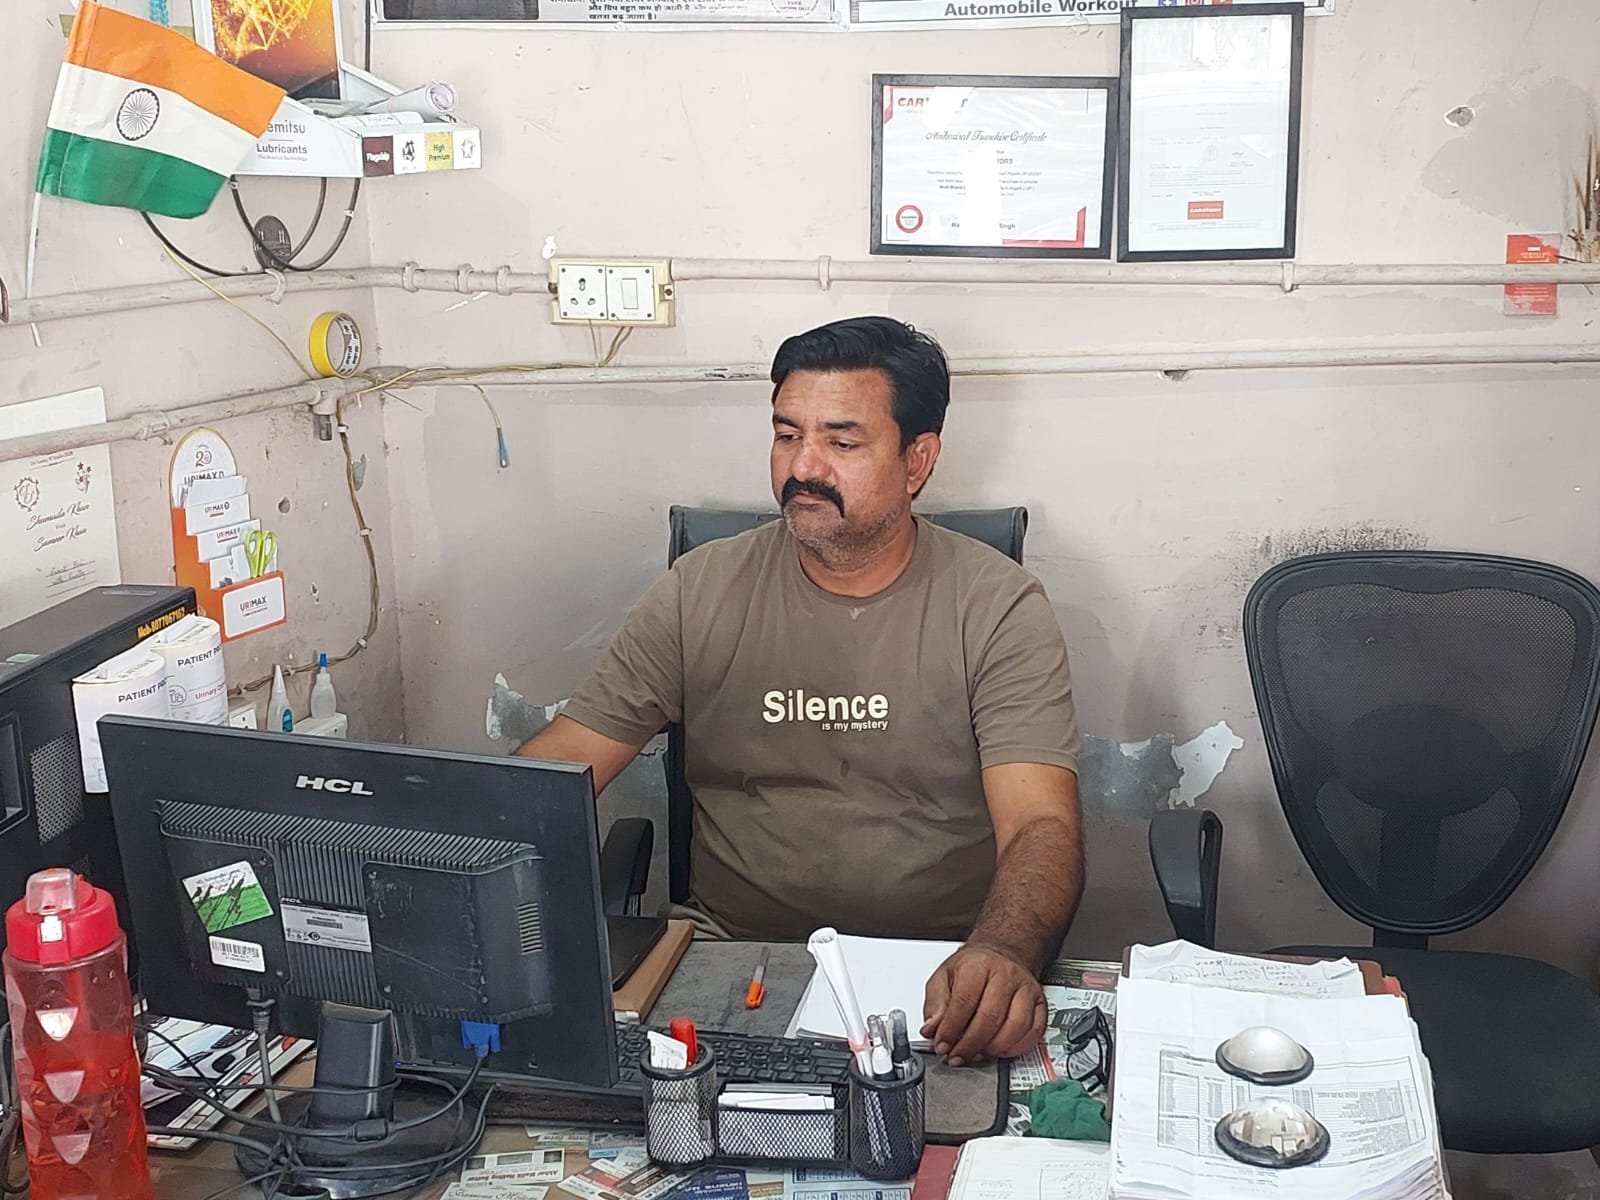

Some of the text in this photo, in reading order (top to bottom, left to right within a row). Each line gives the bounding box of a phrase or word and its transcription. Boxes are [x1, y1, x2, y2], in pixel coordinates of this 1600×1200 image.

[944, 0, 1053, 16] Automobile
[267, 120, 306, 134] emitsu
[256, 143, 308, 154] Lubricants
[433, 143, 446, 153] High
[240, 596, 267, 611] URIMAX
[178, 650, 213, 667] PATIENT
[118, 685, 157, 703] PATIENT
[195, 689, 217, 700] Urinary
[763, 689, 889, 723] Silence
[834, 722, 849, 732] my
[851, 720, 888, 731] mystery
[296, 775, 374, 796] HCL
